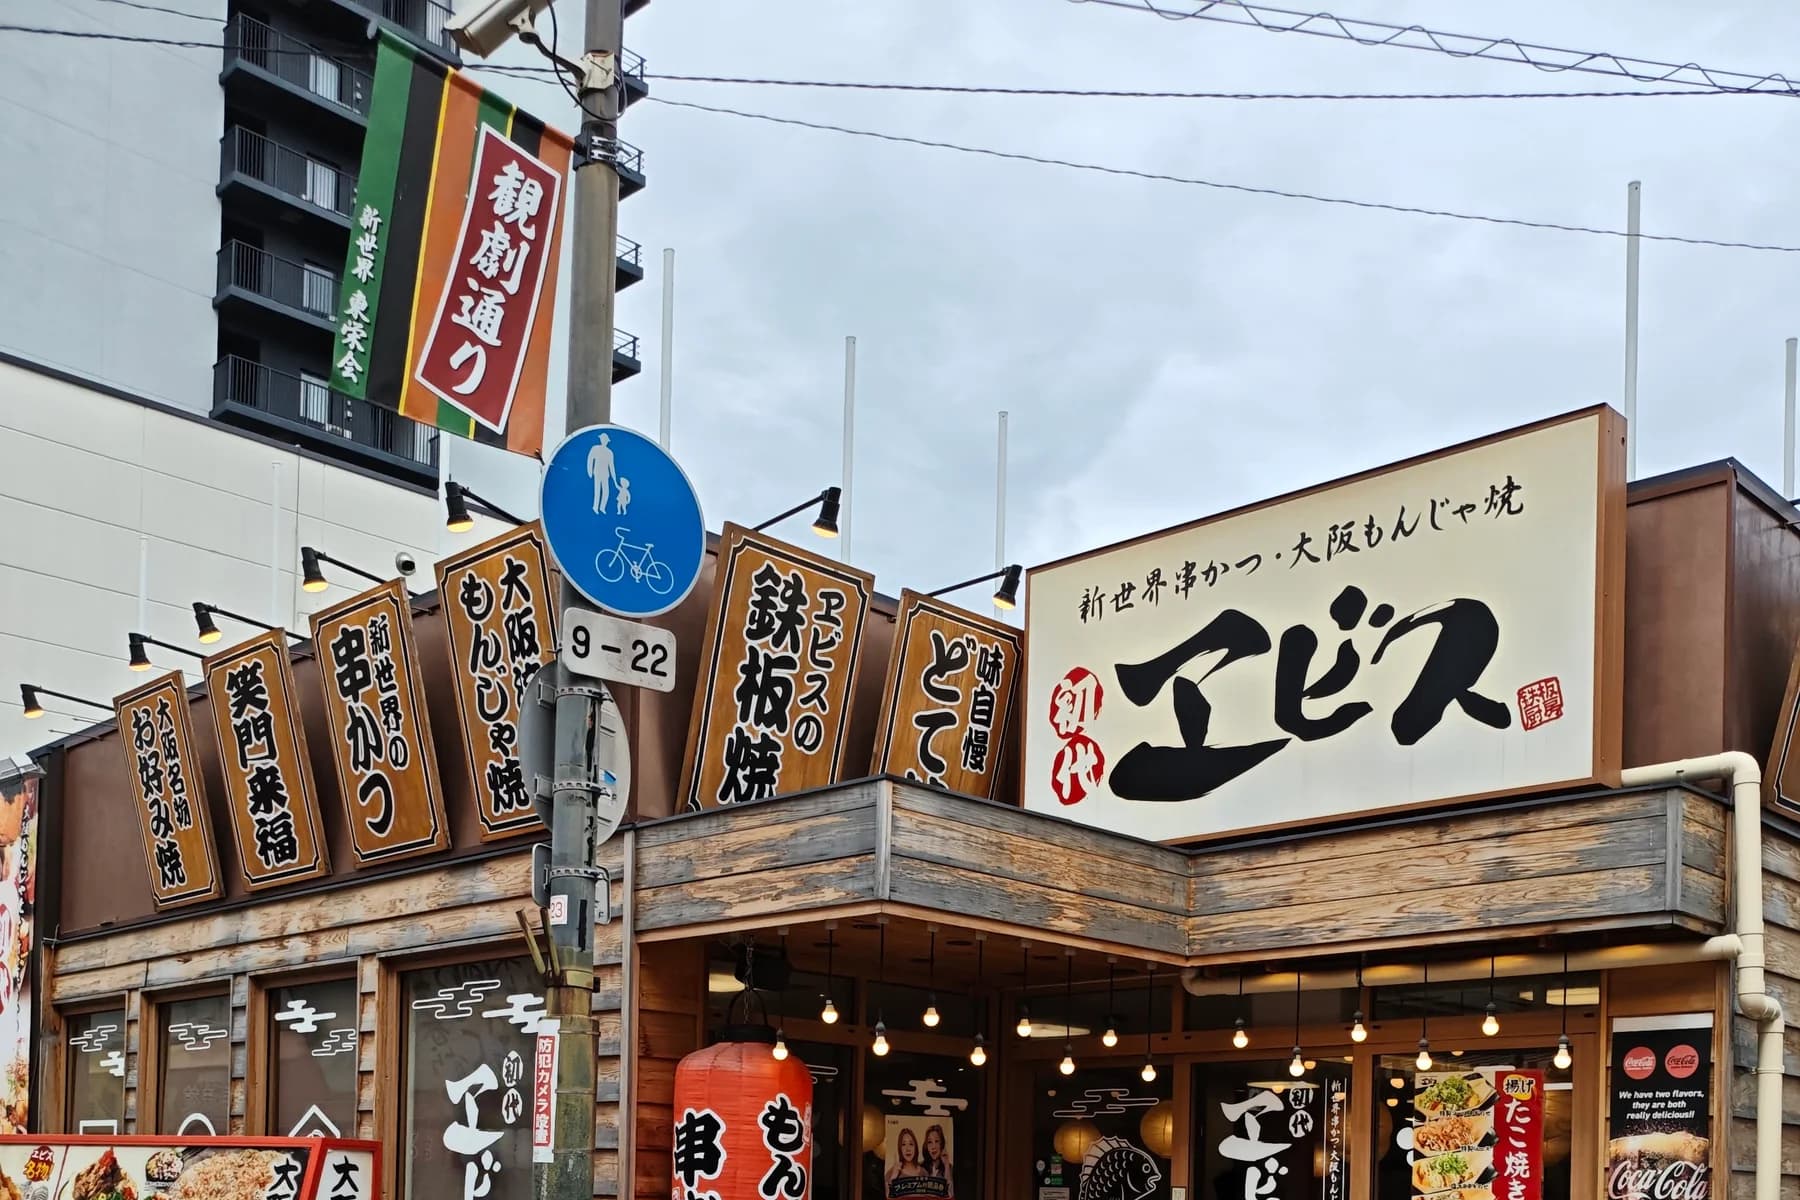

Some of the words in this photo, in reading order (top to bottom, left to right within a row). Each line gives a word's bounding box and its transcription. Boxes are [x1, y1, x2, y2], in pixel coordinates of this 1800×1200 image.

[351, 204, 384, 284] 新世界
[450, 160, 544, 395] 観劇通り
[335, 289, 371, 384] 東栄会
[330, 625, 394, 838] 串かつ
[367, 612, 410, 771] 新世界の
[458, 572, 532, 816] もんじゃ焼
[717, 561, 810, 805] 鉄板焼
[905, 629, 978, 791] どて
[961, 642, 1003, 774] 味自慢
[1048, 666, 1105, 806] 初代
[130, 706, 188, 890] お好み焼
[156, 696, 194, 832] 大阪名物
[225, 659, 299, 869] 笑門来福
[502, 1050, 524, 1124] 初代
[533, 1036, 554, 1146] 防犯カメラ設置
[1504, 1078, 1535, 1094] 揚げ
[1618, 1091, 1632, 1099] We
[1633, 1090, 1653, 1099] have
[1655, 1090, 1670, 1098] two
[1672, 1089, 1705, 1098] flavors,
[1626, 1111, 1651, 1120] really
[1632, 1101, 1650, 1110] they
[1651, 1101, 1665, 1109] are
[1667, 1099, 1687, 1108] both
